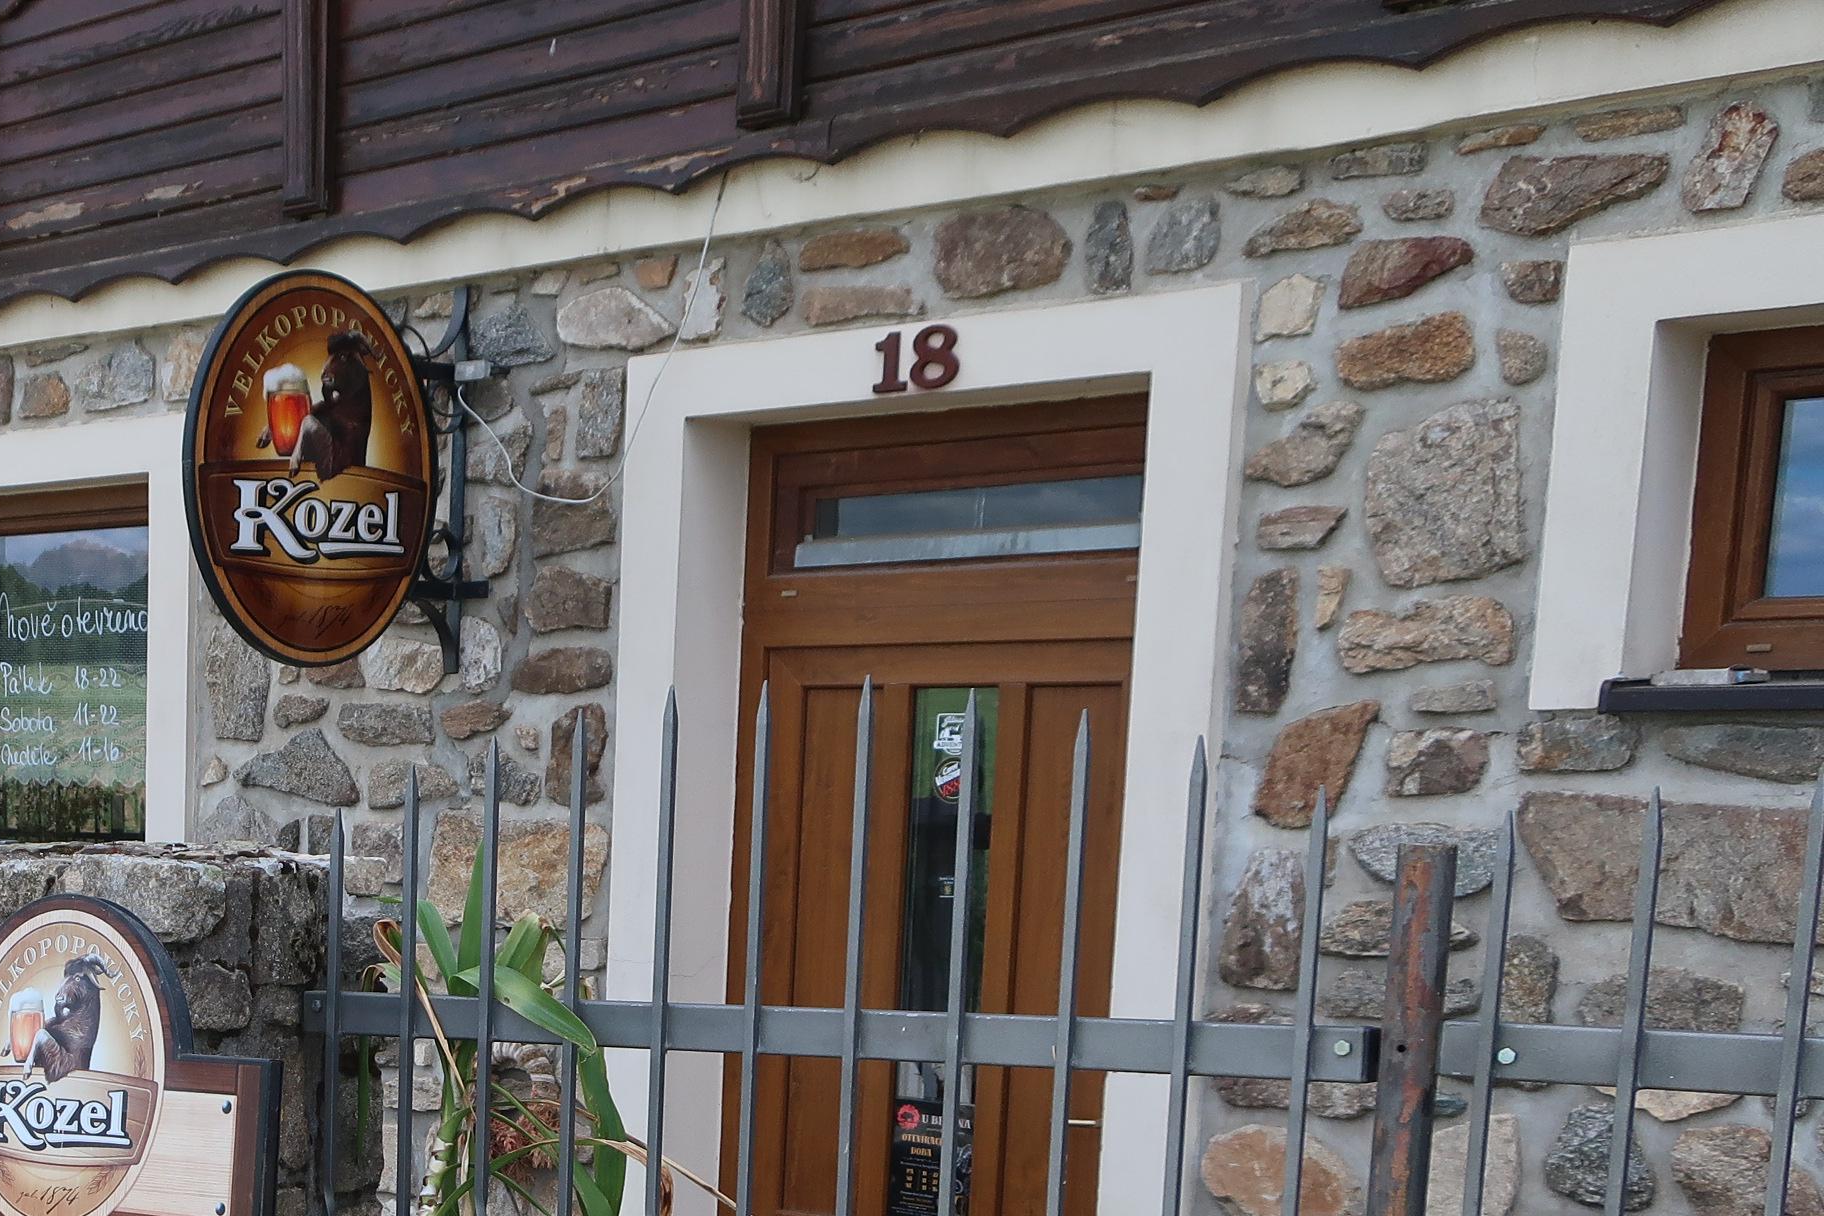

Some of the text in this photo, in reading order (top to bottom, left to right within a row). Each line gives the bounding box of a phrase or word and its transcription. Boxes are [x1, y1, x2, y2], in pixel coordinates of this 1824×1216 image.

[872, 323, 960, 394] 18
[229, 478, 406, 562] Kozel
[0, 661, 122, 697] Pátek 18-22
[0, 702, 119, 733] Sobota 11-22
[78, 736, 120, 762] 11-16
[921, 1113, 929, 1124] U
[931, 1115, 972, 1130] BINA
[39, 1185, 81, 1215] 1874
